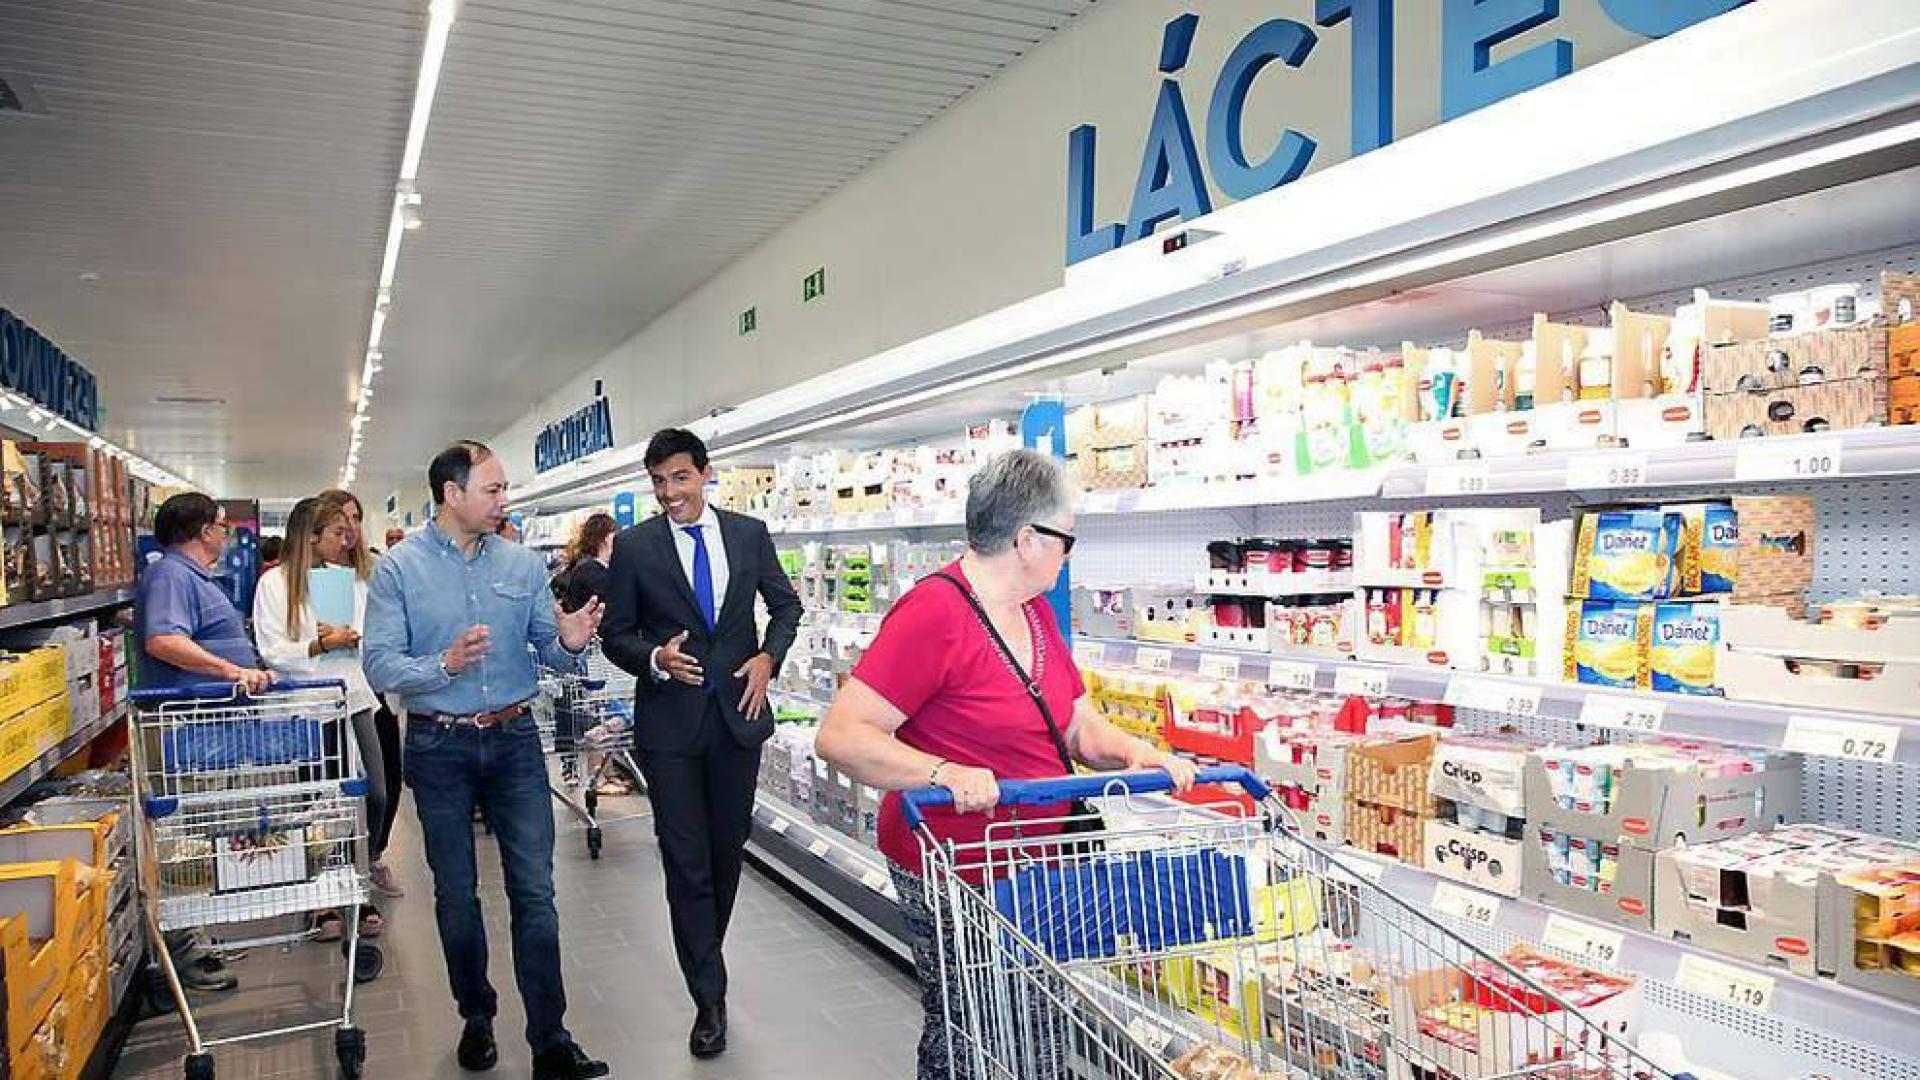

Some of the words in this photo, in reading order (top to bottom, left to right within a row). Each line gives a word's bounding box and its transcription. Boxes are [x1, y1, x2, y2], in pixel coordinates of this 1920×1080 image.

[1066, 0, 1752, 266] LÁCTE
[1793, 456, 1832, 474] 1.00
[1662, 622, 1709, 641] Danet
[1843, 737, 1887, 759] 0.72
[1442, 760, 1483, 784] Crisp
[1448, 839, 1488, 864] Crisp
[1585, 940, 1615, 960] 1.19
[1729, 983, 1764, 1006] 1.19
